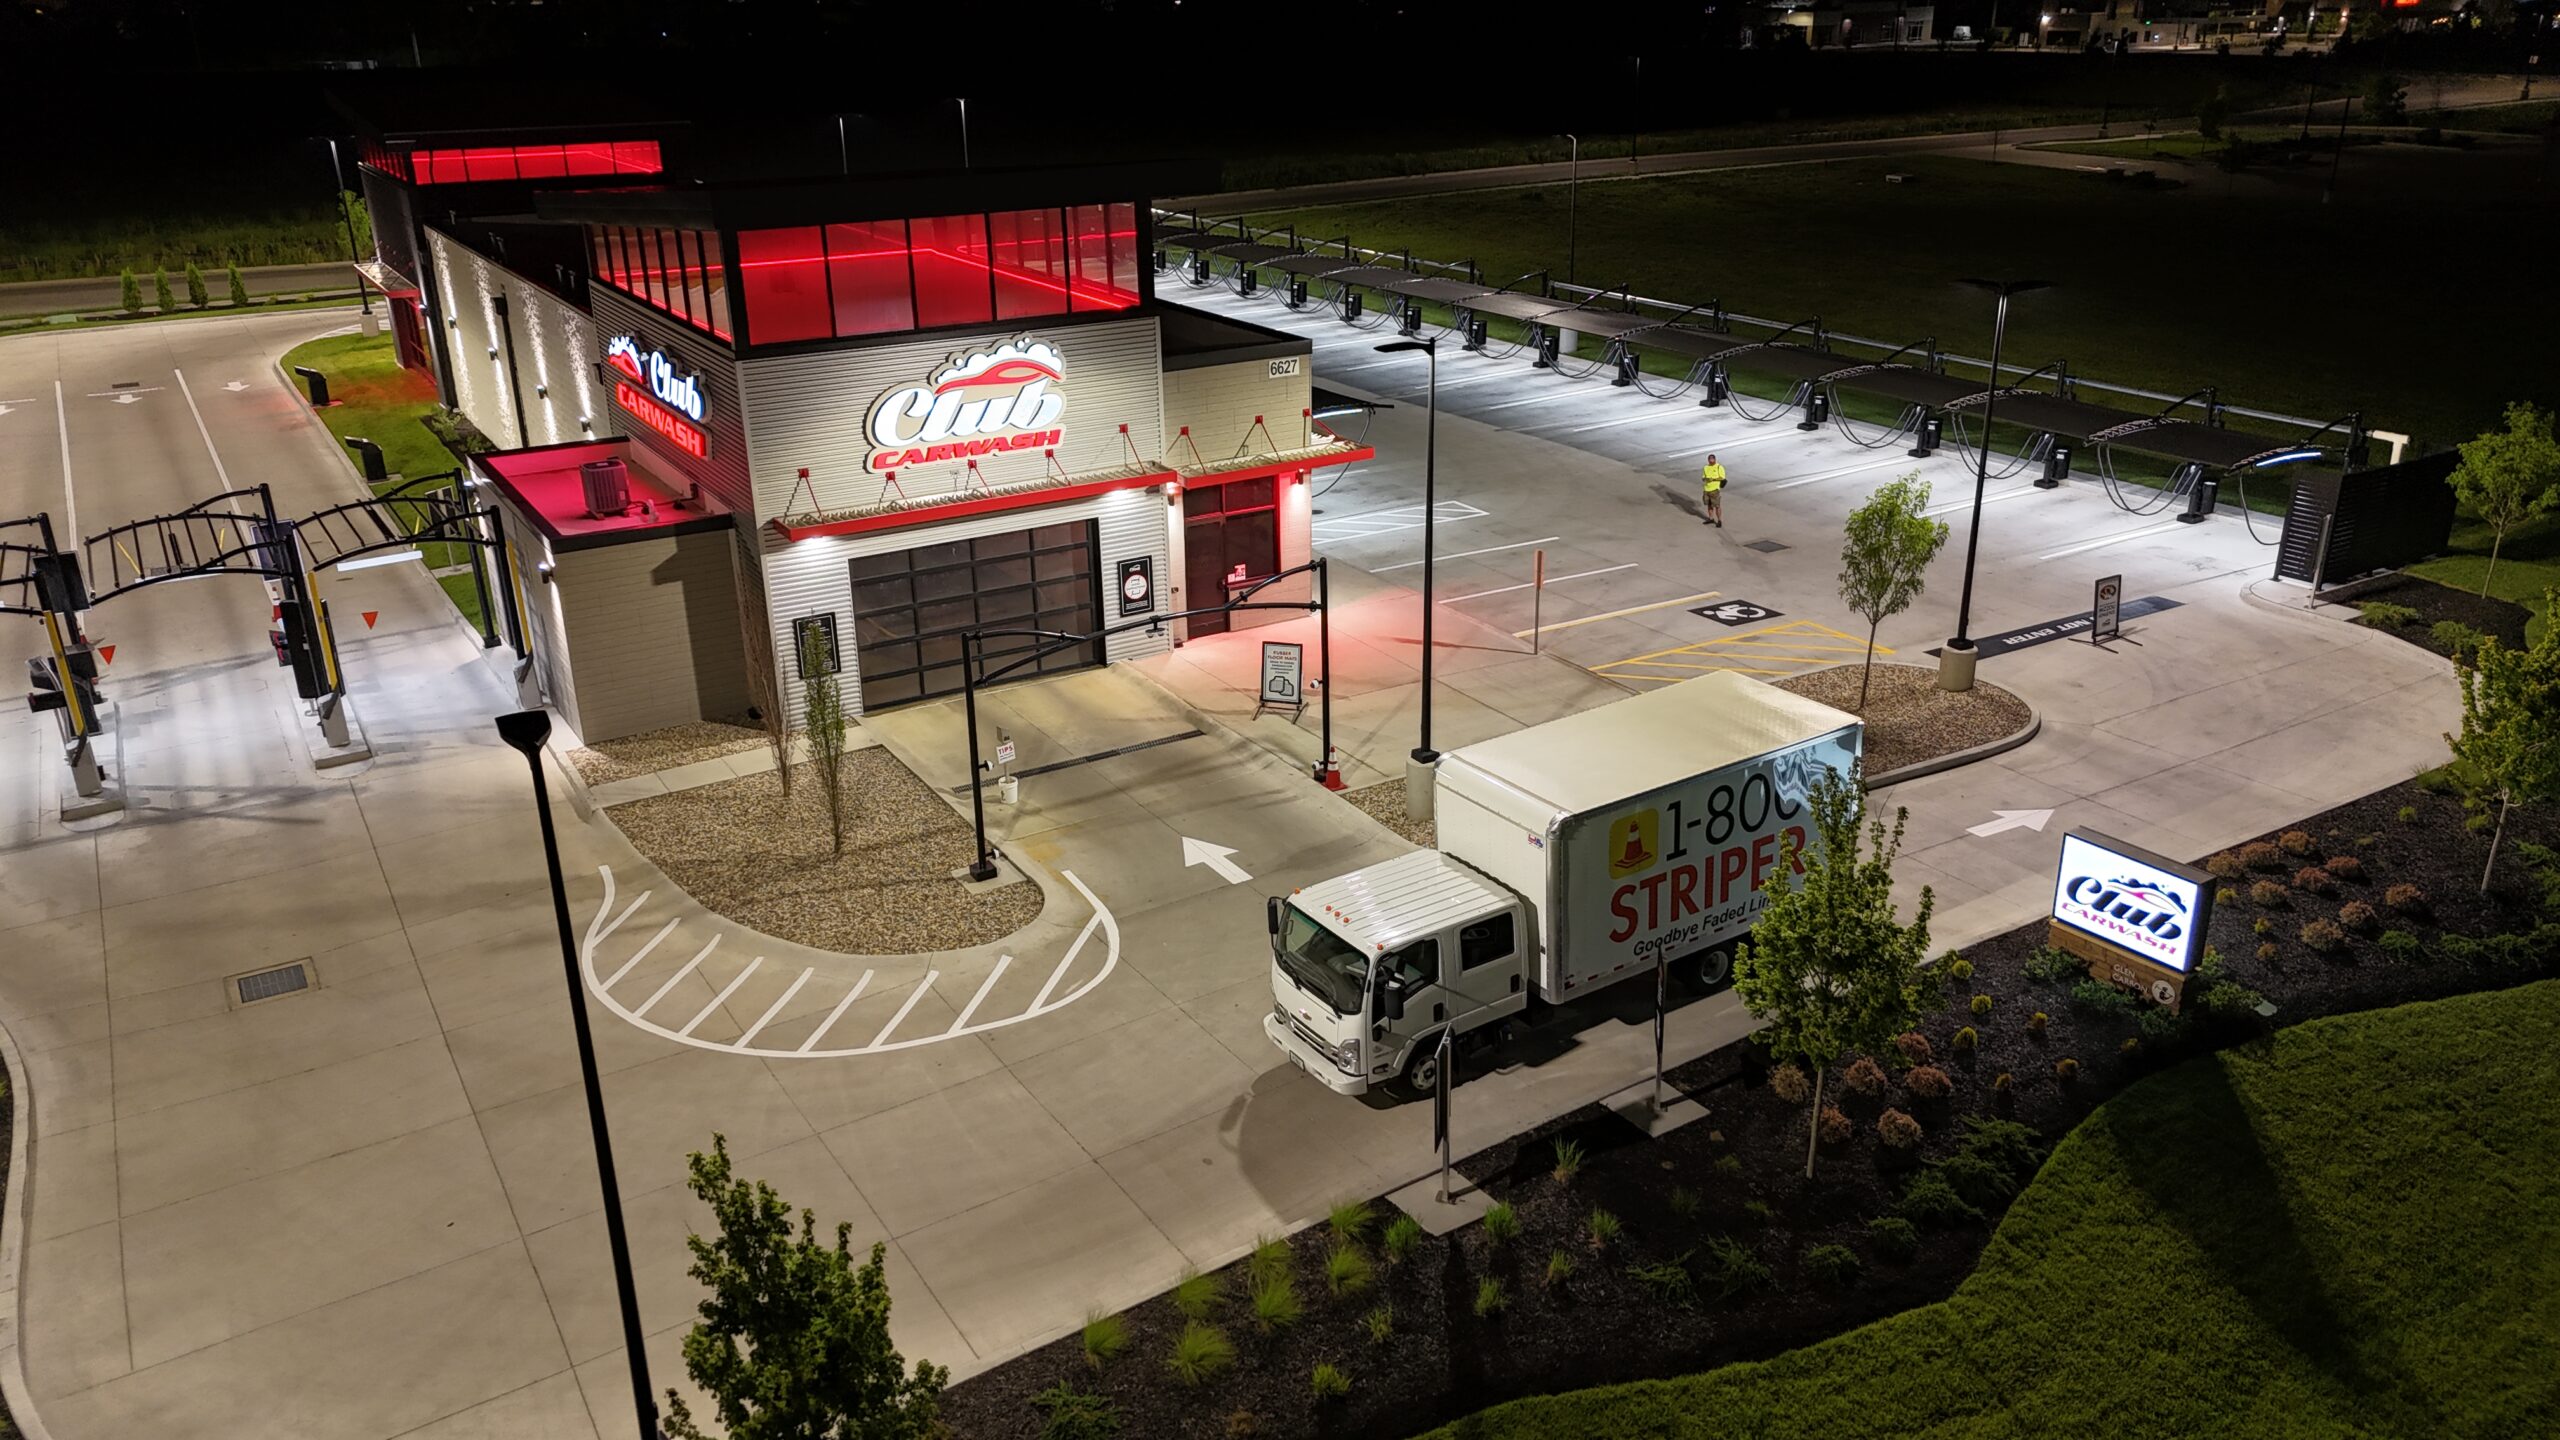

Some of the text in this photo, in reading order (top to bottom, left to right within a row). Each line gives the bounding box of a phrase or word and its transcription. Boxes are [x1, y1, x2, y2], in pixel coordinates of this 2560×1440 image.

[650, 350, 703, 421] Club
[1270, 359, 1298, 376] 6627
[616, 381, 703, 457] CARWASH
[872, 376, 1064, 447] Club
[873, 429, 1061, 470] CARWASH
[2002, 627, 2057, 645] ENTER
[999, 745, 1013, 754] TIPS
[1608, 825, 1806, 943] STRIPER
[2066, 876, 2182, 940] Club
[1633, 895, 1771, 956] Goodbye Faded Lin
[2062, 902, 2177, 955] CARWASH
[2113, 964, 2135, 978] GLEN
